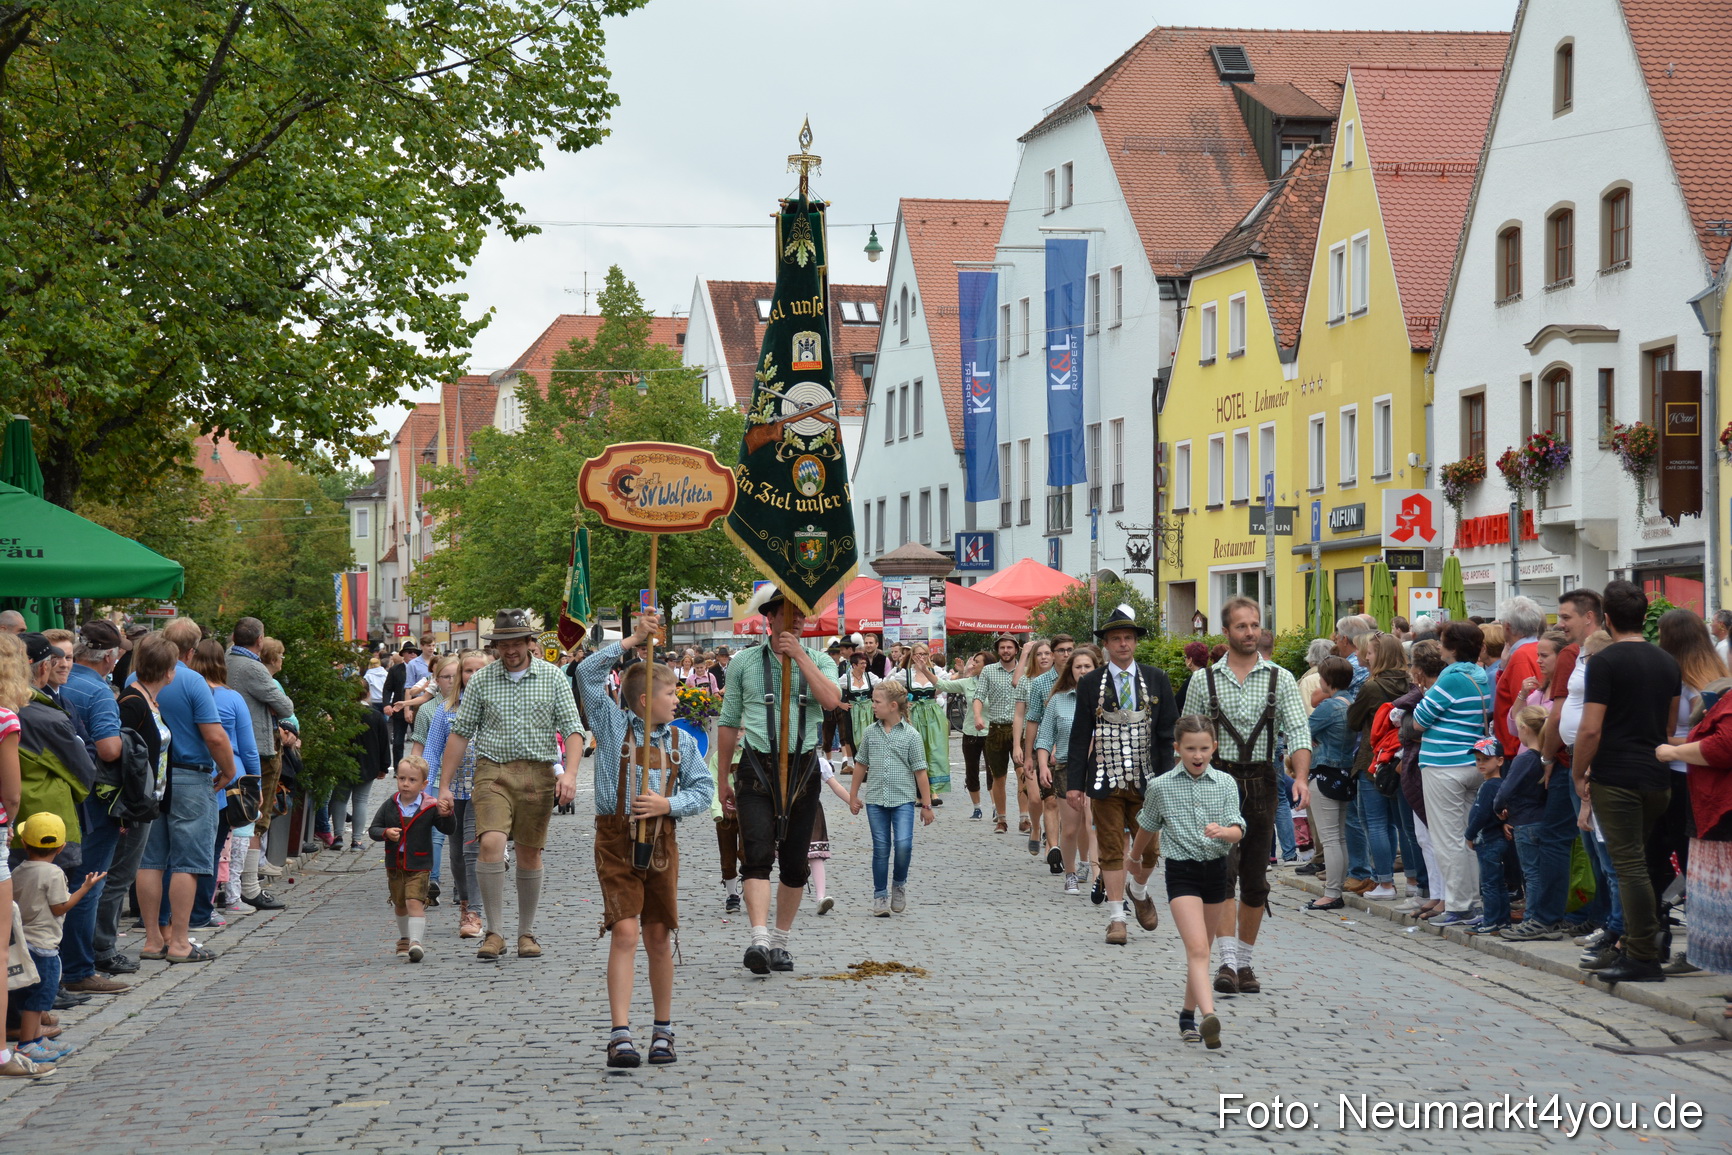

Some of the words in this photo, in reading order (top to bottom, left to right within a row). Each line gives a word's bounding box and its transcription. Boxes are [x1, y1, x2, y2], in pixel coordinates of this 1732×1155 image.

[1050, 334, 1071, 391] K&L
[1071, 334, 1079, 390] RUPPERT
[1216, 391, 1247, 424] HOTEL
[1254, 385, 1290, 413] Lehmeier
[639, 484, 658, 508] SV
[658, 475, 713, 508] Wolfstein
[754, 481, 792, 511] Ziel
[1252, 523, 1291, 532] TAUN
[1312, 507, 1319, 537] P
[1327, 507, 1357, 529] TAIFUN
[1213, 537, 1257, 559] Restaurant
[1470, 569, 1490, 580] APOTHEKE
[1531, 562, 1554, 574] APOTHEKE
[707, 603, 728, 612] APOLLO
